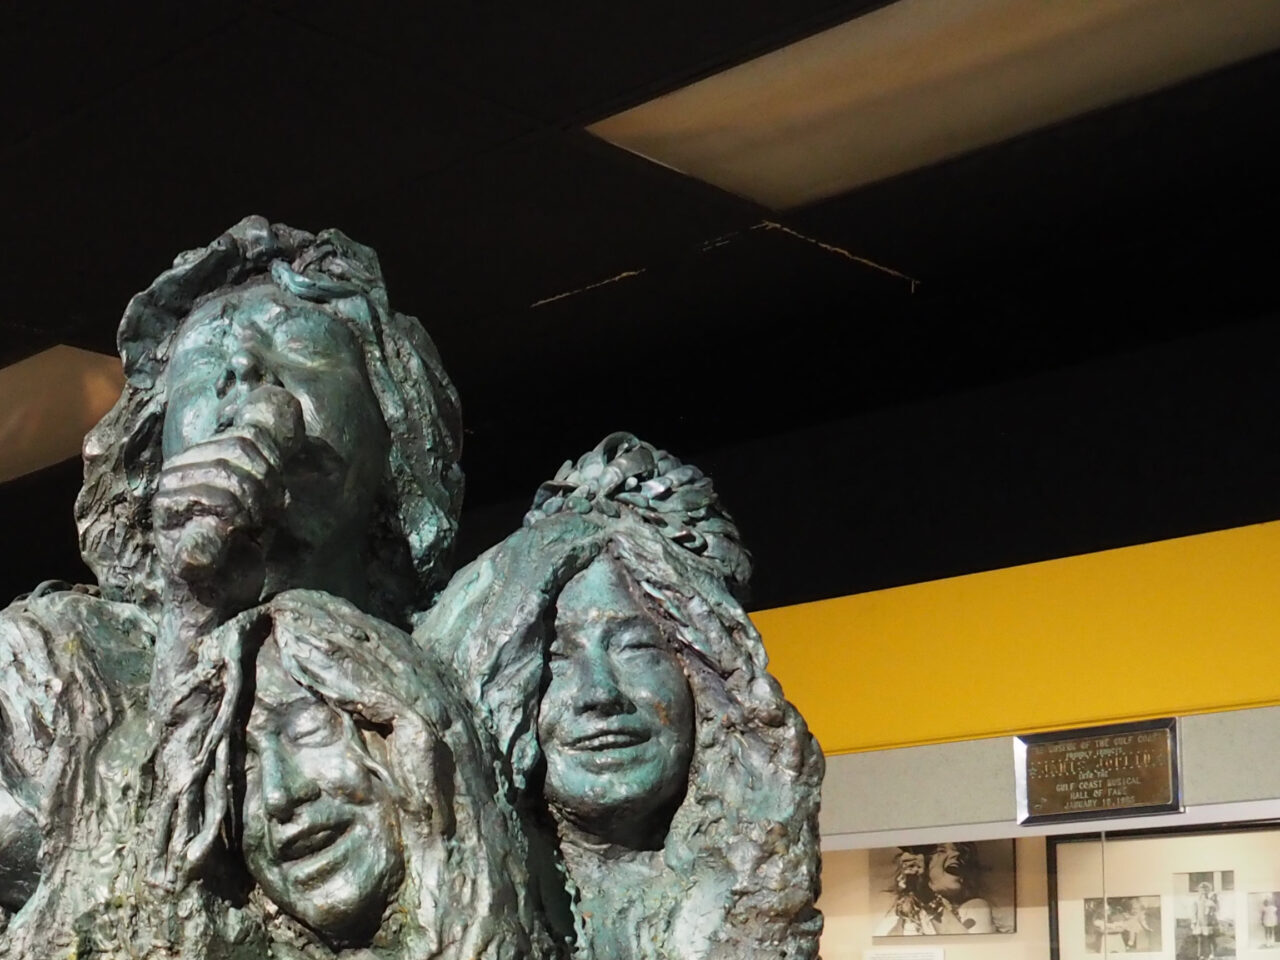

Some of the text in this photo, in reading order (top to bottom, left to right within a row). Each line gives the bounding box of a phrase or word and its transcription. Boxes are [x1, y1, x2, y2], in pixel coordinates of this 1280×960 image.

[1056, 782, 1075, 792] GULF
[1078, 780, 1103, 789] COAST
[1070, 791, 1089, 800] HALL
[1093, 789, 1103, 798] OF
